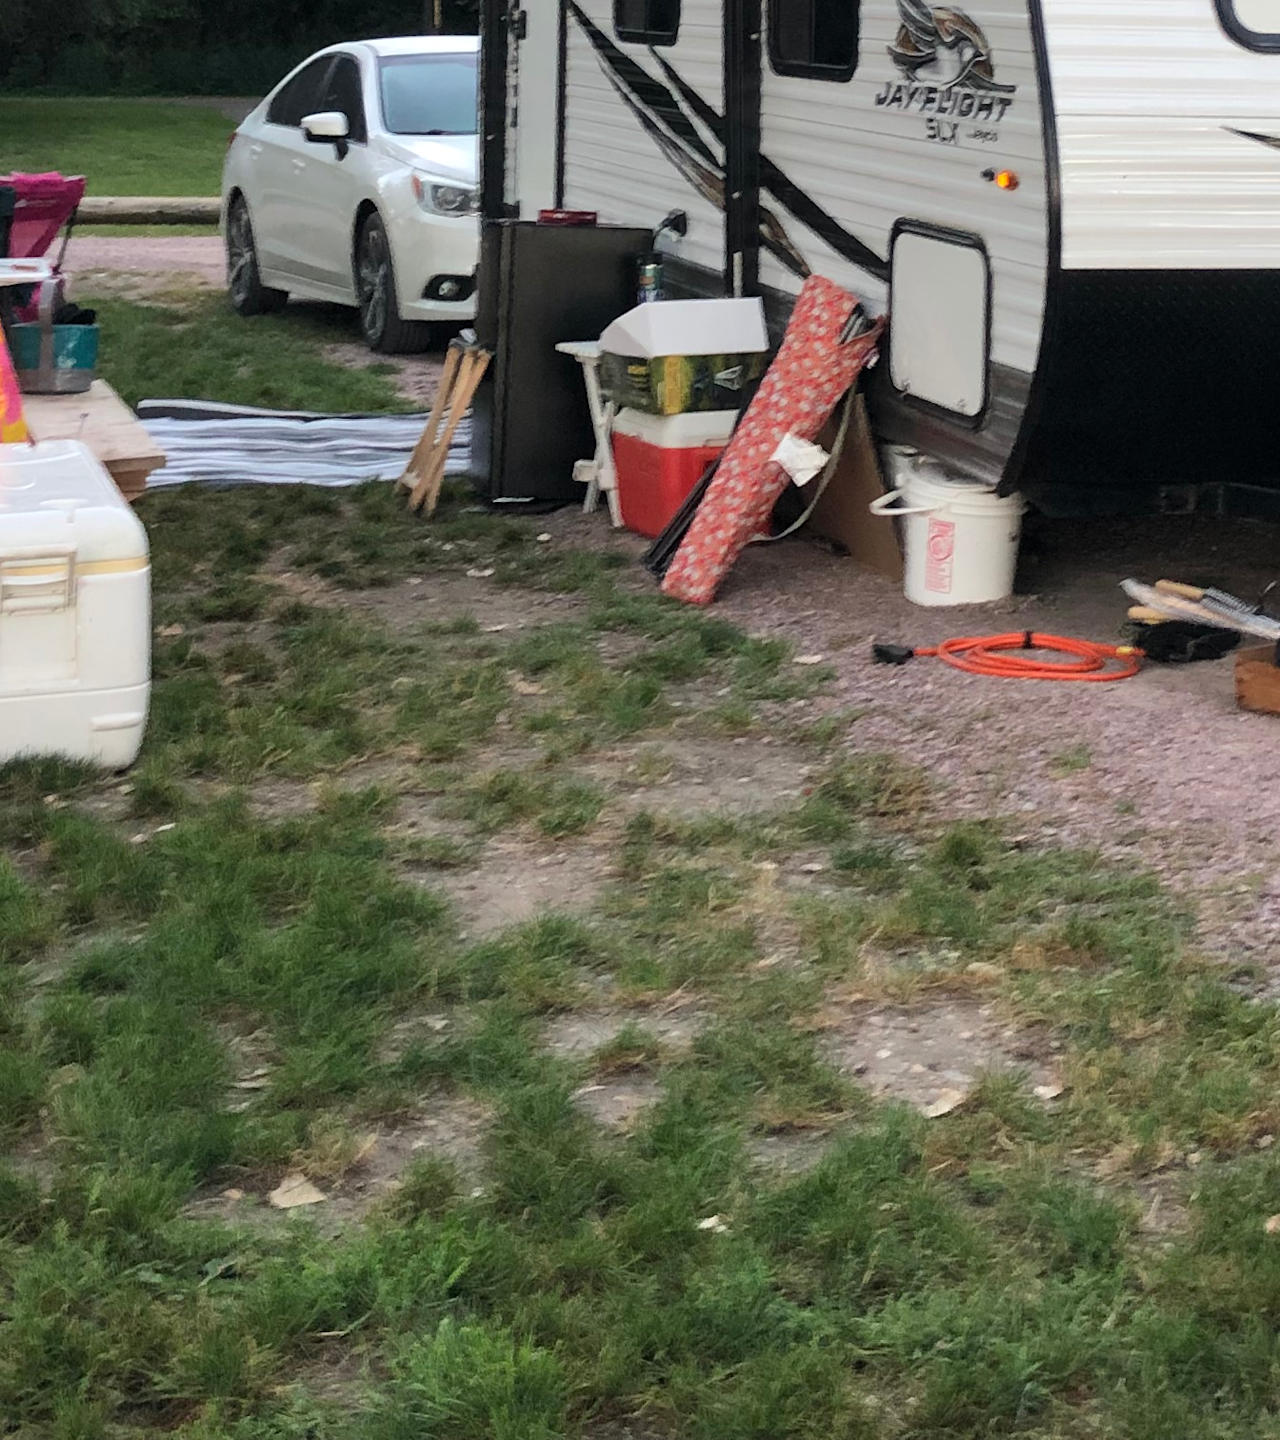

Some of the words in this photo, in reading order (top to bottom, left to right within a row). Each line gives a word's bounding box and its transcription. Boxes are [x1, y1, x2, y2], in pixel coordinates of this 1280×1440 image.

[875, 80, 919, 109] JAY
[918, 85, 1014, 122] FLIGHT
[925, 117, 960, 145] SLX
